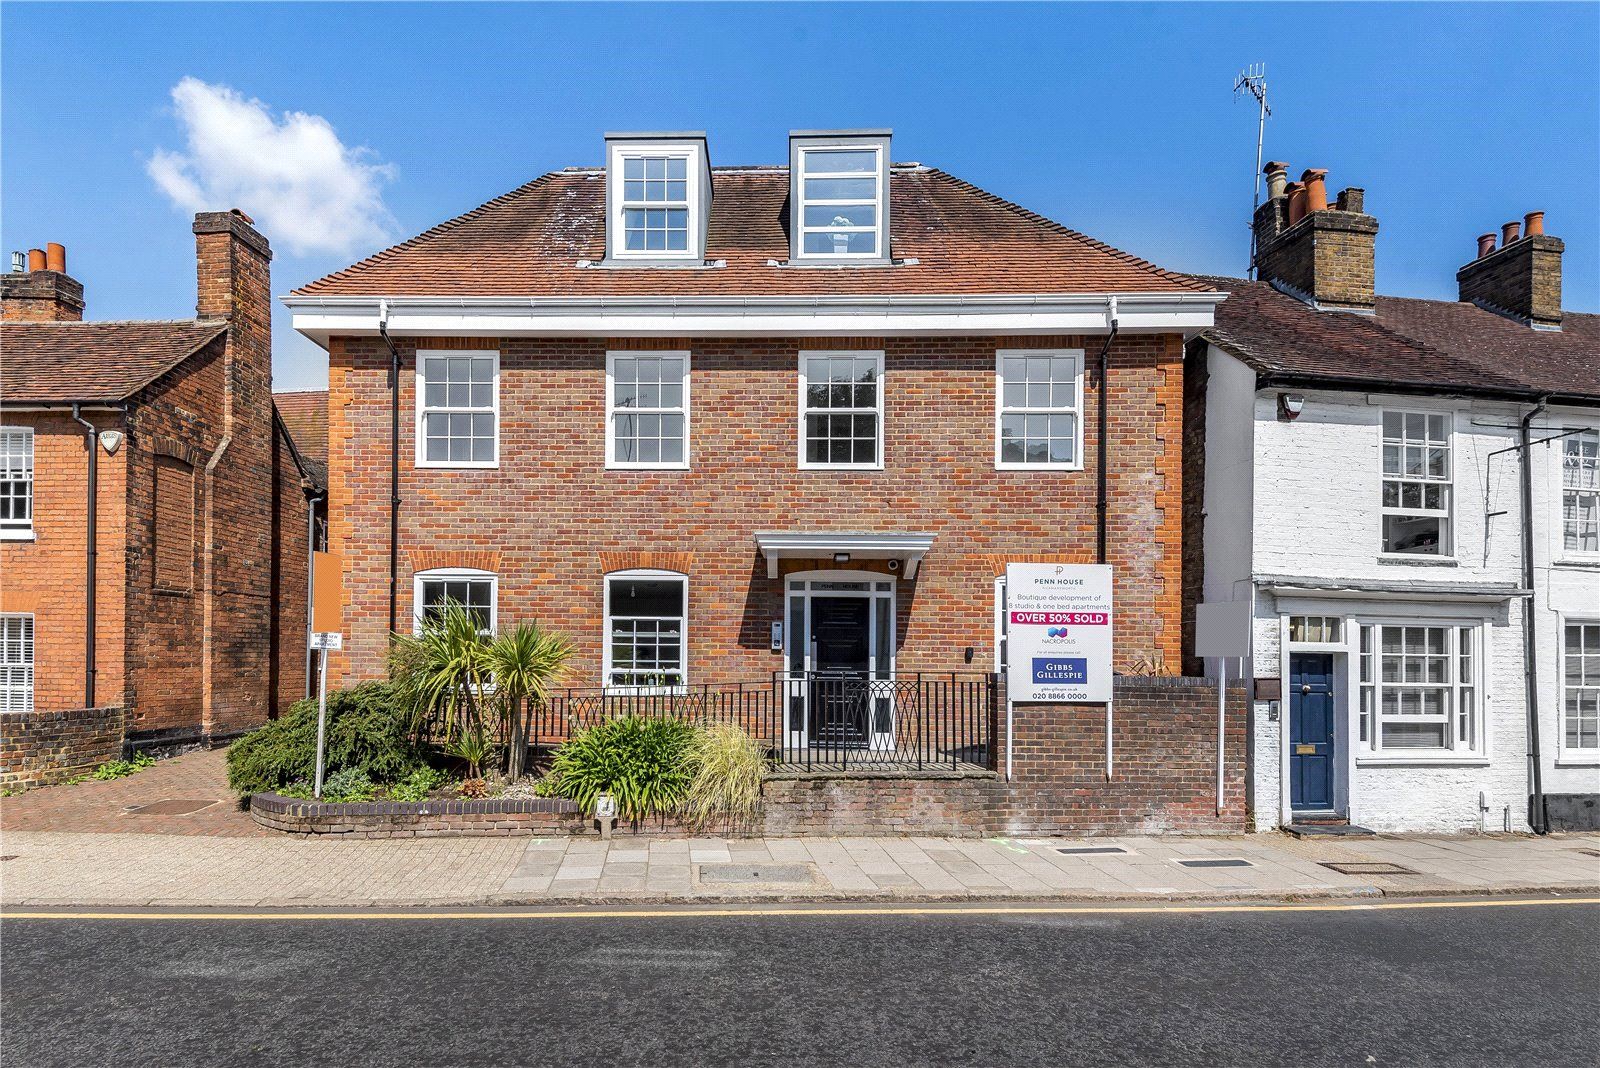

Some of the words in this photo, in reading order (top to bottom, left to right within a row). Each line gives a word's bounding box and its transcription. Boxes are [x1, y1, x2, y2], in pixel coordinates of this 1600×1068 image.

[1017, 594, 1046, 602] Boutique
[1048, 594, 1092, 603] development
[1016, 614, 1046, 622] OVER
[1049, 614, 1071, 623] 50%
[1074, 614, 1103, 623] SOLD
